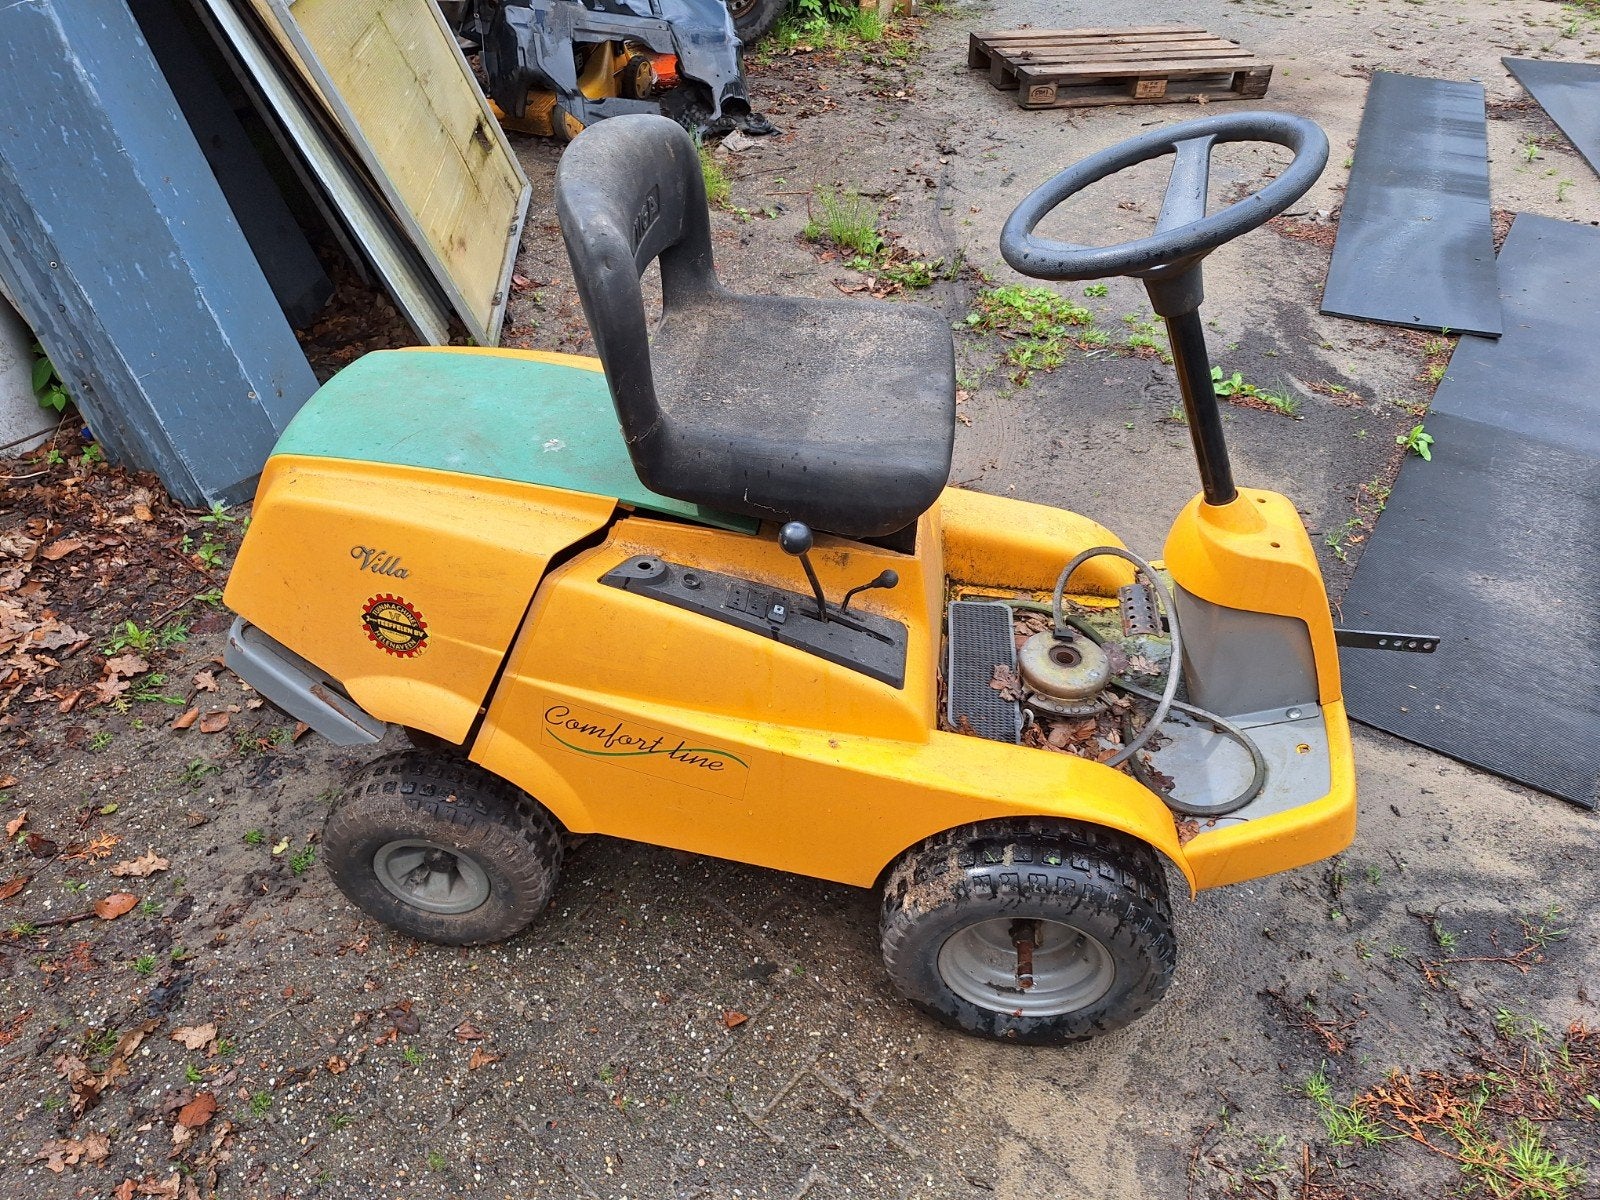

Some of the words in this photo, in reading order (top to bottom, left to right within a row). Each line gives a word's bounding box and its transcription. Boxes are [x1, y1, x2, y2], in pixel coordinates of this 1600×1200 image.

[350, 545, 409, 579] Villa
[374, 630, 416, 650] HELENAVEEN
[544, 705, 664, 754] Comfort
